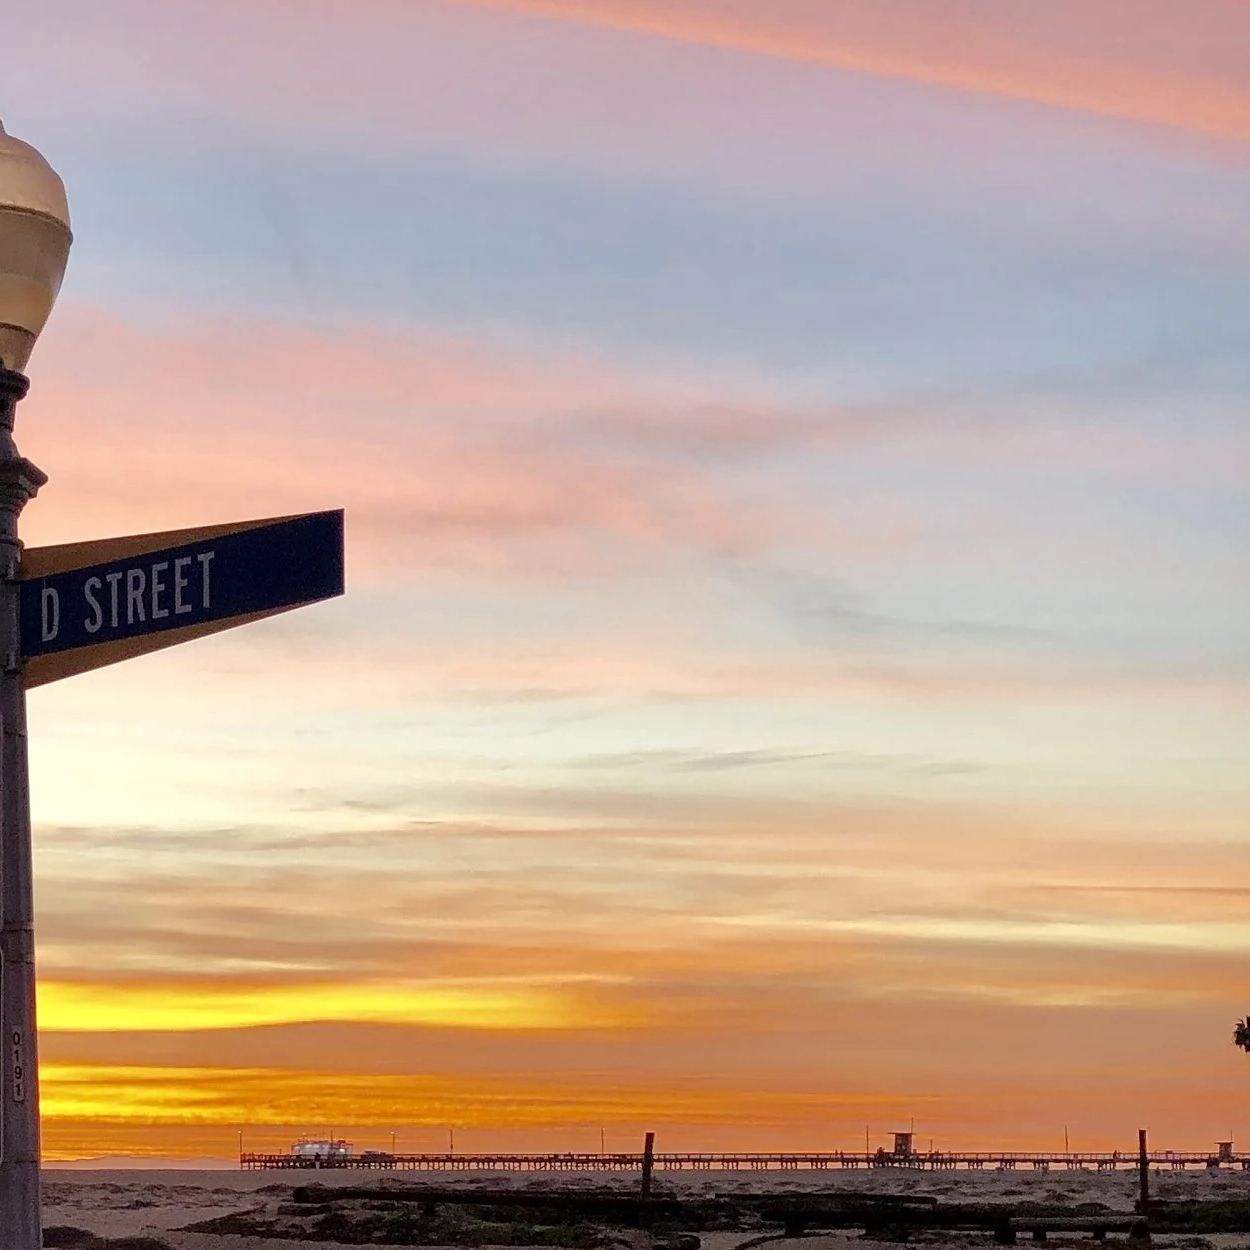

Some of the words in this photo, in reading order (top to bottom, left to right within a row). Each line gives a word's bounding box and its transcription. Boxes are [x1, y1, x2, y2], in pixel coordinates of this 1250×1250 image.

[41, 588, 59, 642] D
[84, 551, 215, 633] STREET
[12, 1031, 23, 1097] 0191
